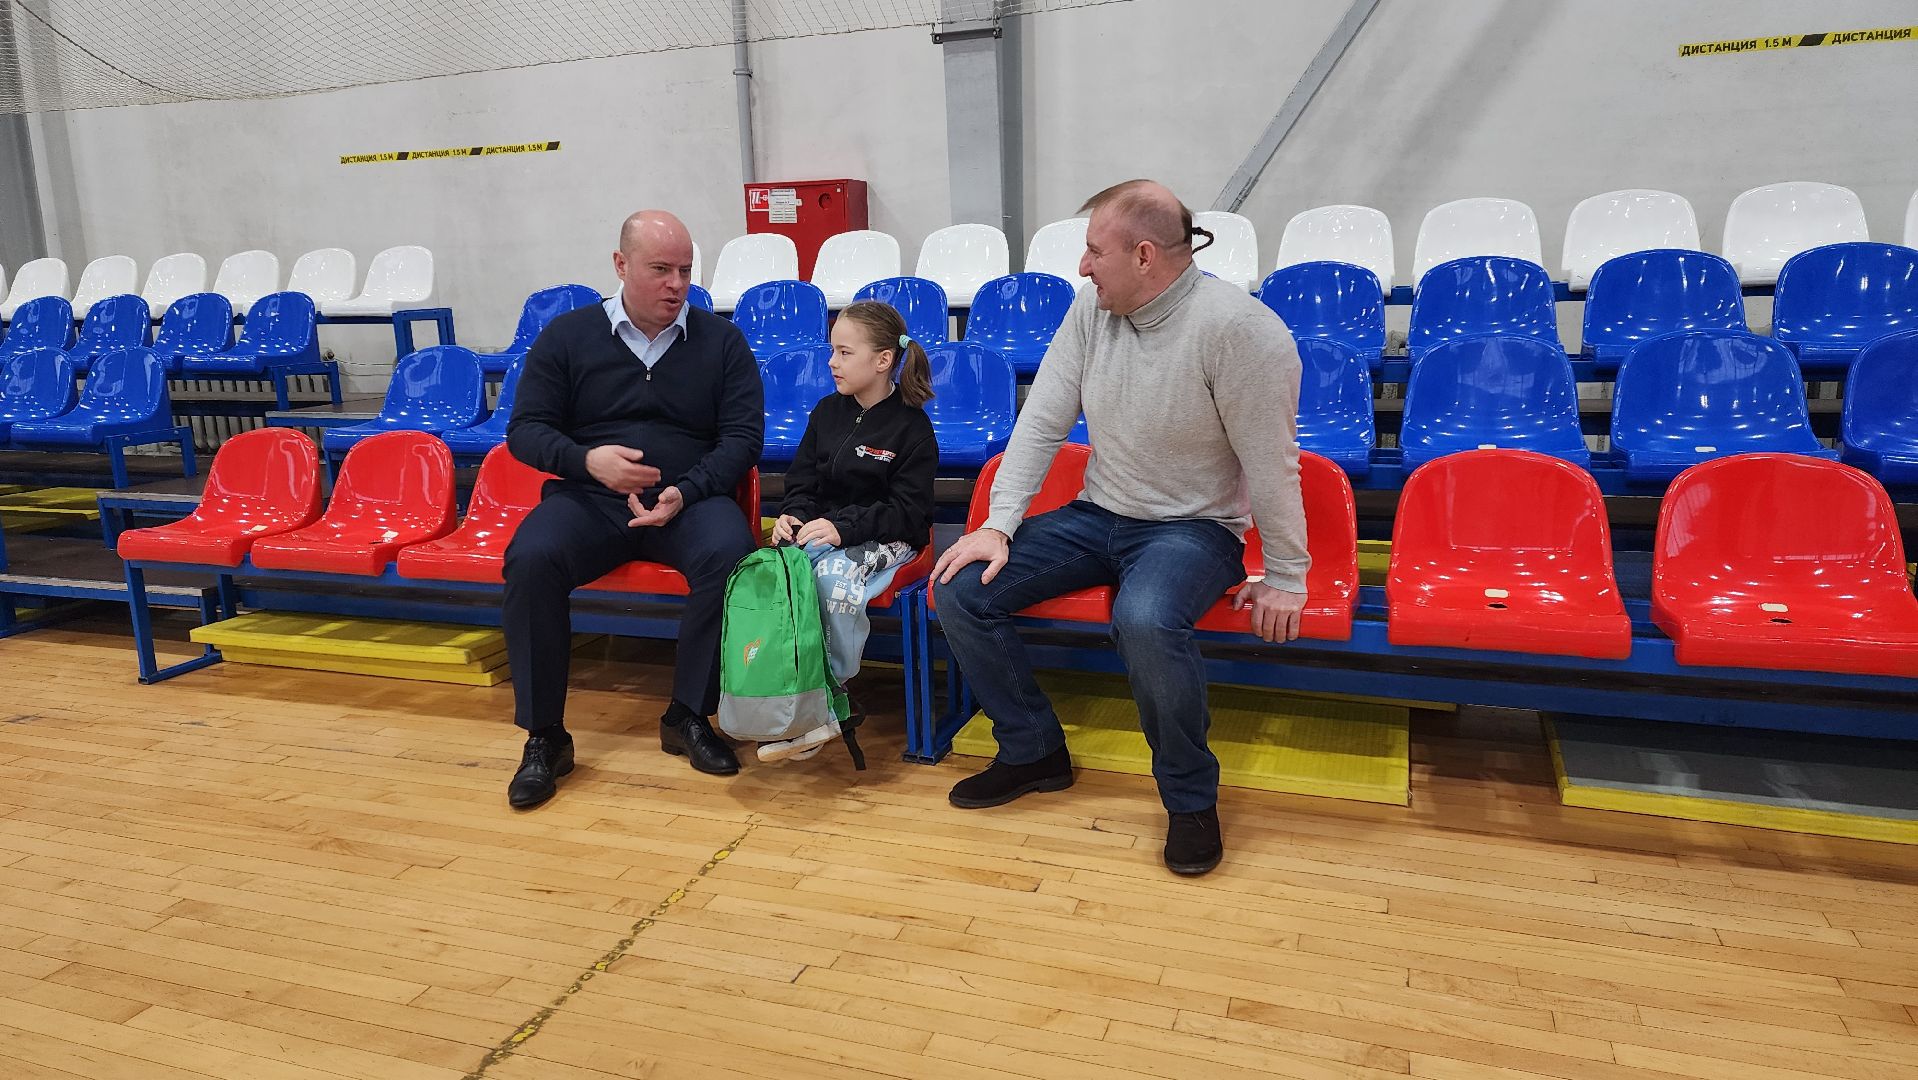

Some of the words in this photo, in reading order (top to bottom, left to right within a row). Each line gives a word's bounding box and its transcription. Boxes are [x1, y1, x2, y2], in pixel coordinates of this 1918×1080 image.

[1681, 40, 1757, 56] ДИСТАНЦИЯ
[1764, 38, 1779, 48] 1.5
[1831, 28, 1912, 45] ДИСТАНЦИЯ
[341, 155, 376, 164] ДИСТАНЦИЯ
[412, 150, 449, 159] ДИСТАНЦИЯ
[486, 145, 525, 155] ДИСТАНЦИЯ
